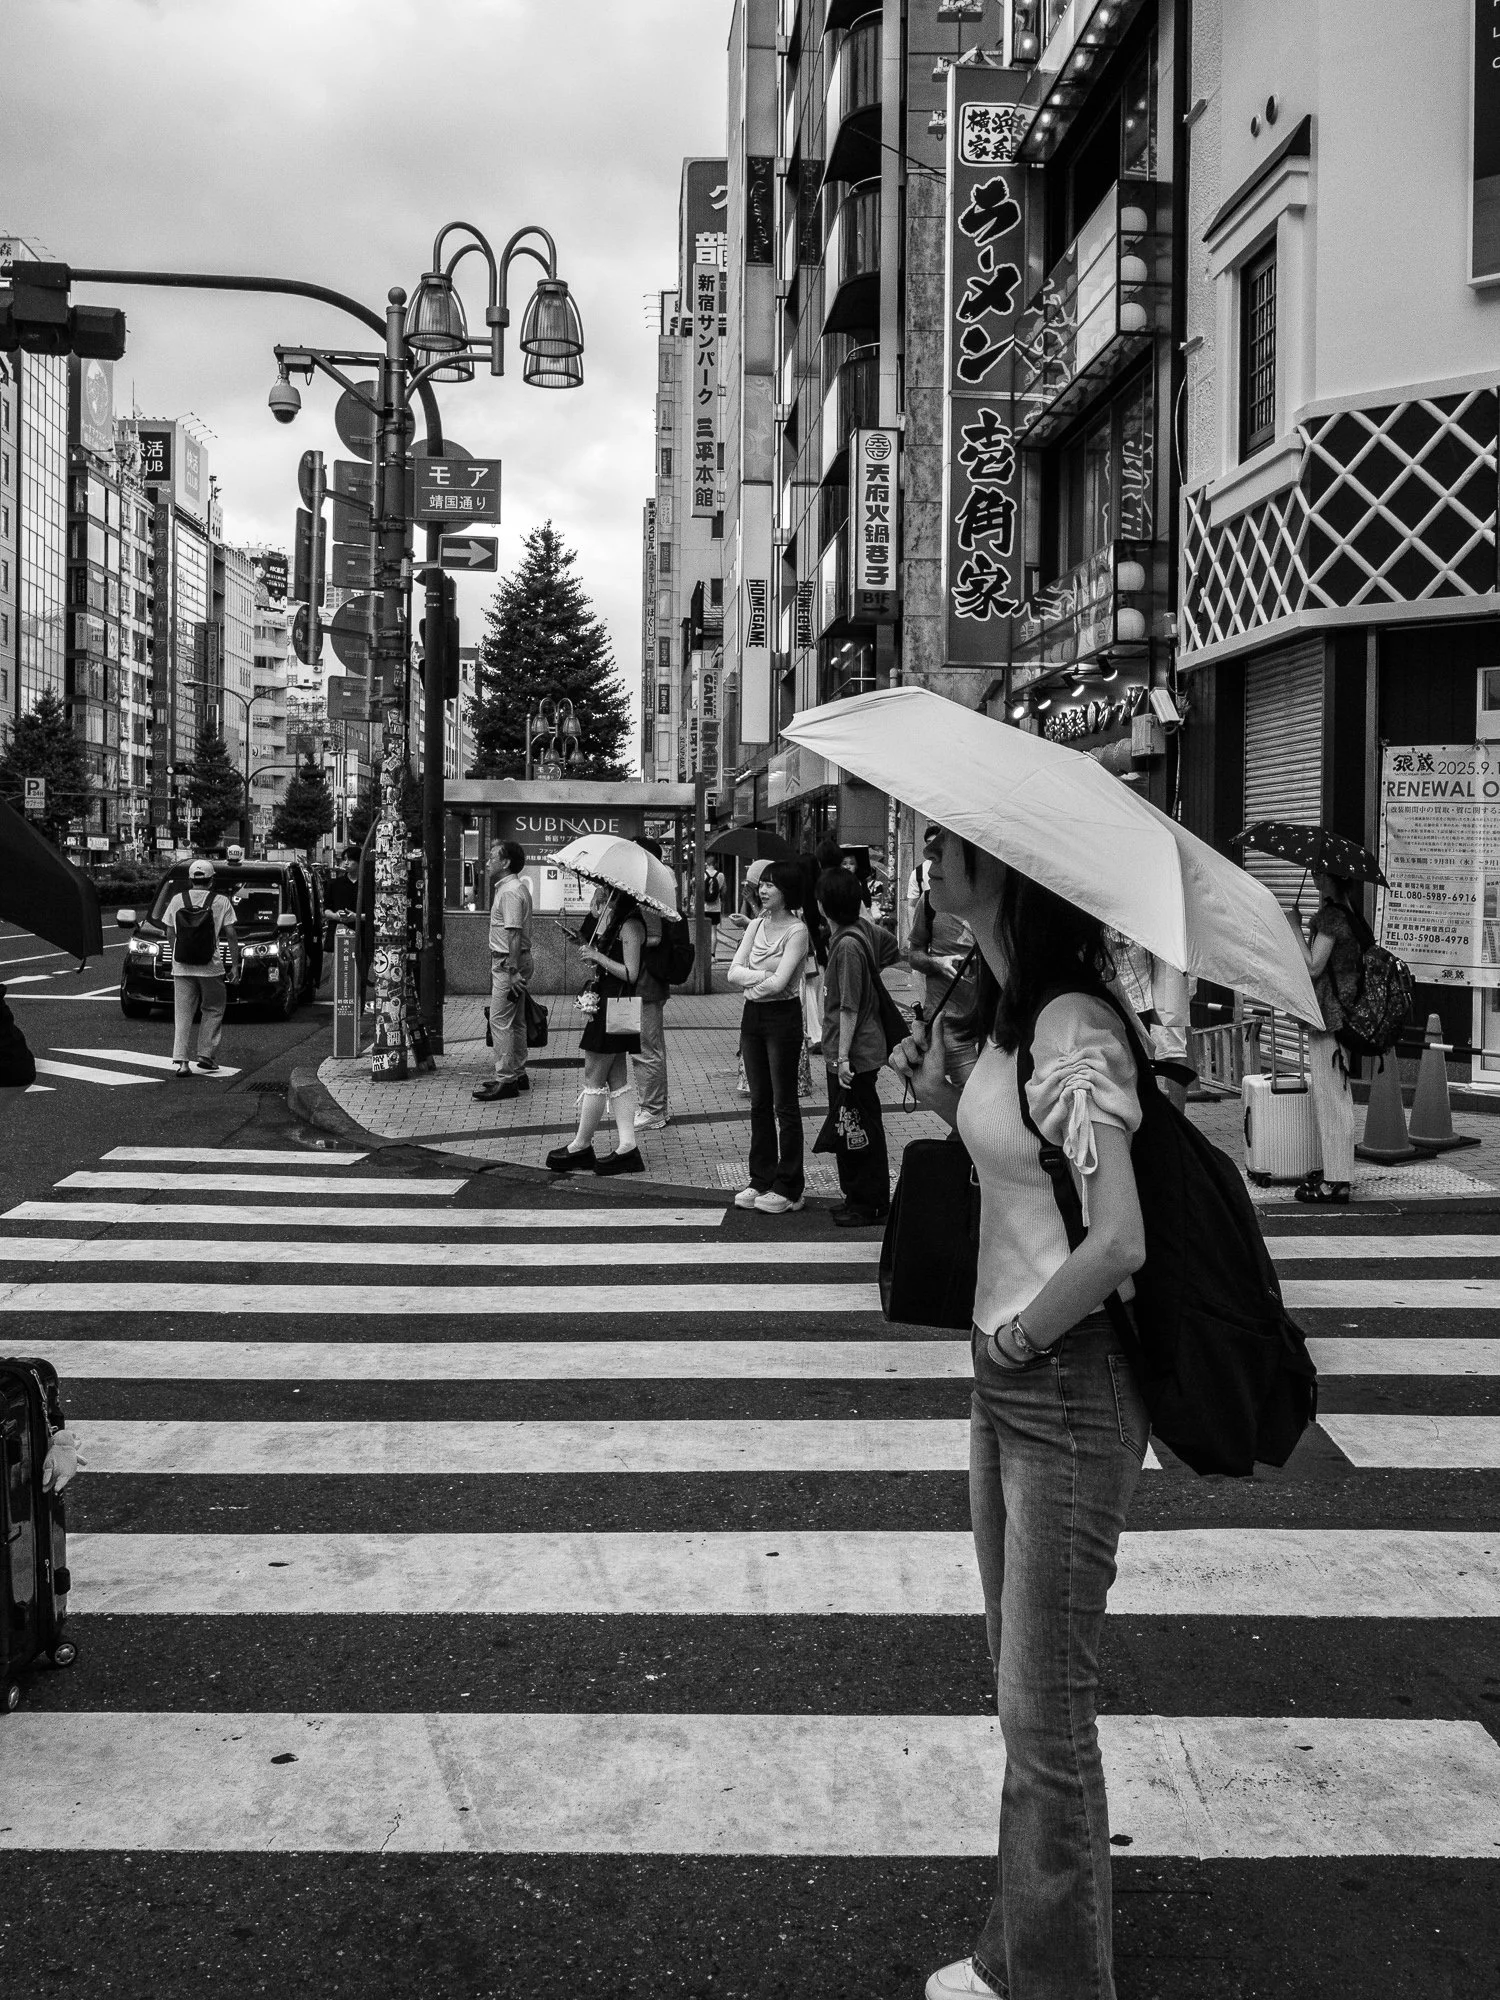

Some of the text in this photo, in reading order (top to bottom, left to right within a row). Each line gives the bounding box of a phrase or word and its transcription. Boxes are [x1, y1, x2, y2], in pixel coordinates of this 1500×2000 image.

[957, 176, 1021, 384] ラーメン
[697, 274, 716, 406] 新宿サンパーク
[695, 417, 715, 507] 三平本館
[429, 466, 489, 487] モア
[429, 494, 486, 510] 靖国通り
[864, 464, 890, 586] 天府火鍋巷子
[951, 407, 1018, 622] 壱角家
[863, 592, 890, 604] B1F
[749, 580, 765, 648] HOMEGAME
[703, 673, 714, 717] GAME
[27, 780, 40, 796] P
[1387, 780, 1475, 798] RENEWAL
[515, 816, 619, 834] SUBNADE
[1389, 890, 1477, 902] TEL.080-5989-6916
[1386, 931, 1469, 945] TEL.03-5908-4978
